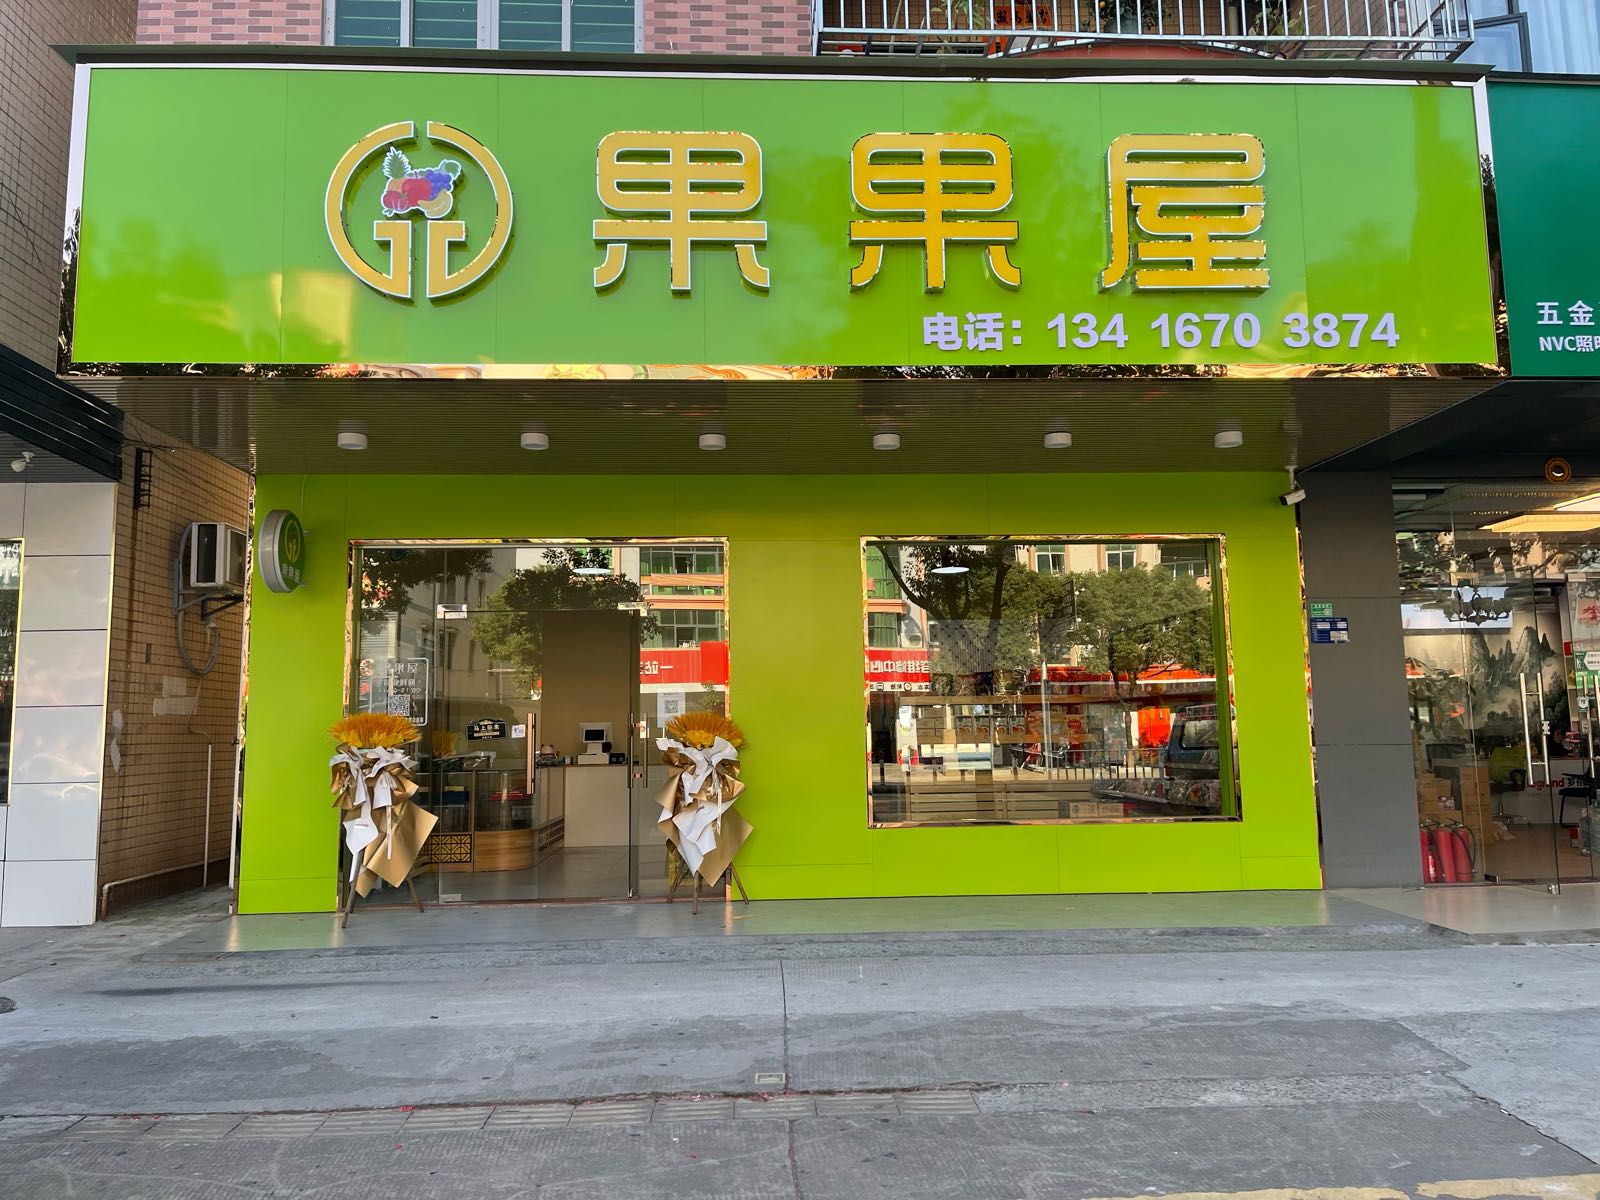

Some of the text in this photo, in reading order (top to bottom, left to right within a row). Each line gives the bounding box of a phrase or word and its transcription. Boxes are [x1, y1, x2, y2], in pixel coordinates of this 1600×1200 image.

[592, 130, 1271, 293] 果果屋
[1047, 313, 1129, 350] 134
[1150, 312, 1262, 349] 1670
[1283, 312, 1400, 349] 3874
[1536, 299, 1600, 326] 五金
